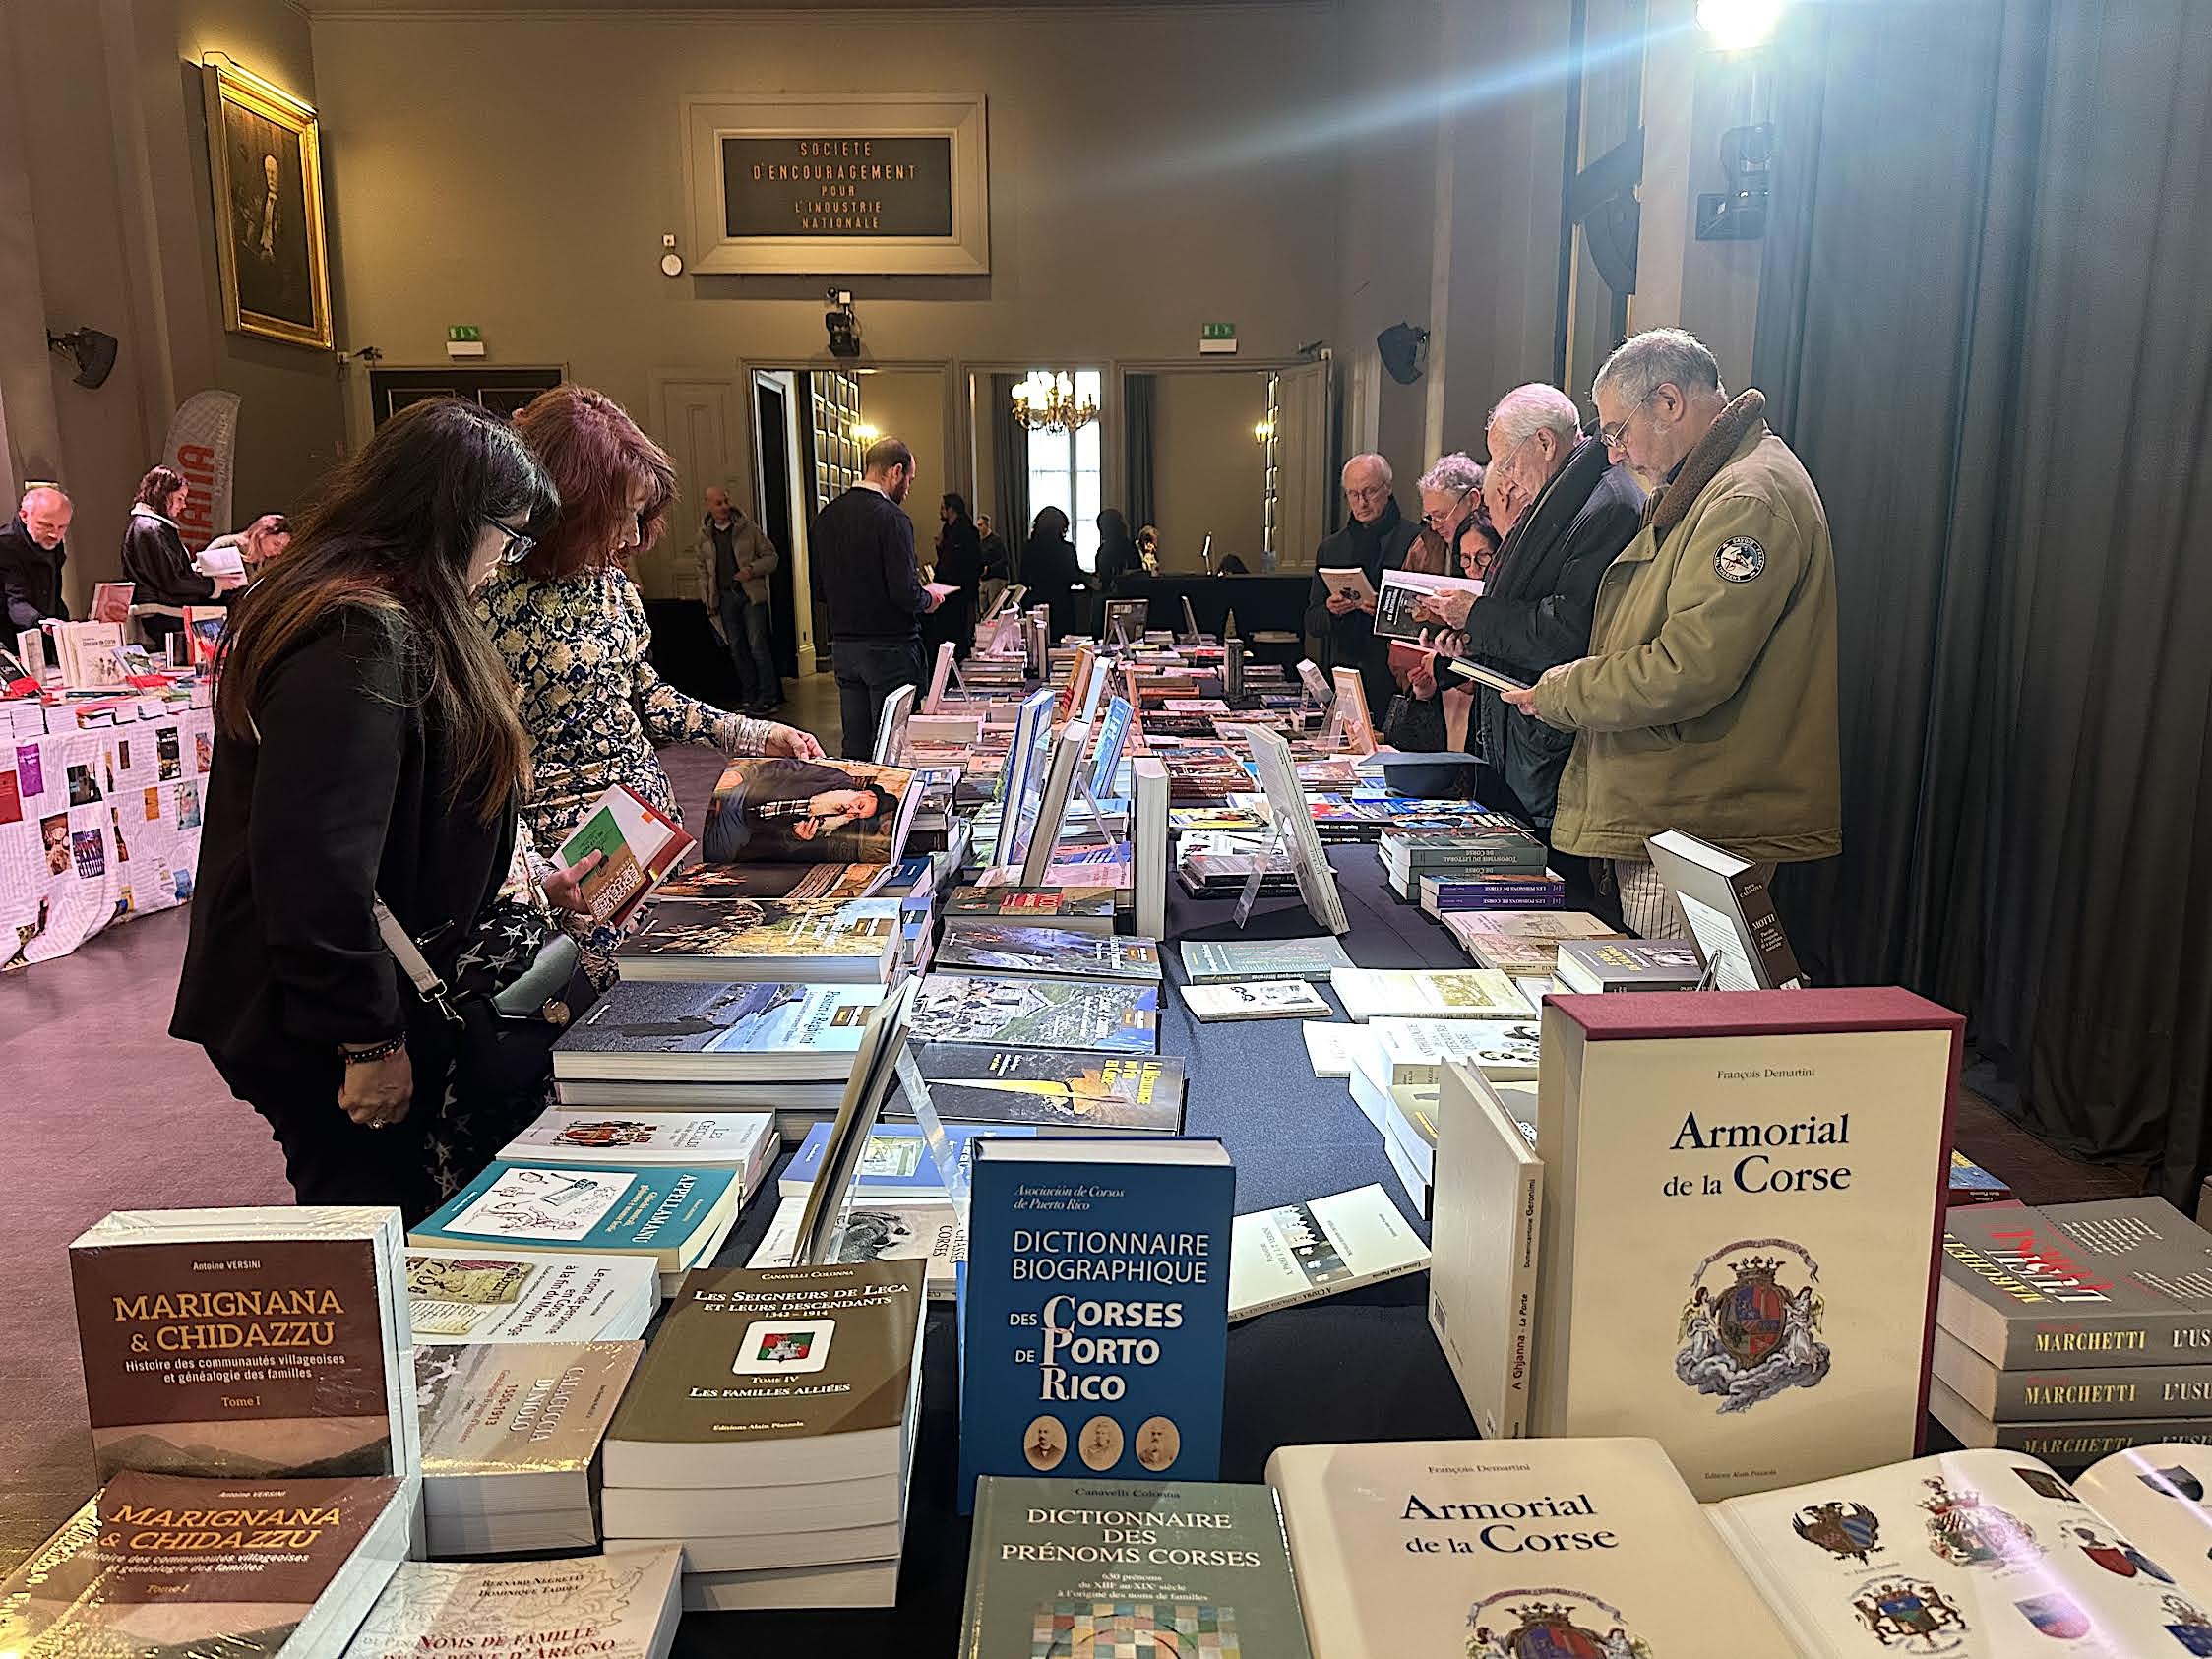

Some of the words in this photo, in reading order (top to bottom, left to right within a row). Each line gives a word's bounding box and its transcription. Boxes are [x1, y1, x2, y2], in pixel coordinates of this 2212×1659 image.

[800, 142, 873, 157] SOCIETE
[753, 162, 916, 181] D'ENCOURAGEMENT
[821, 185, 856, 197] POUR
[795, 200, 882, 214] L'INDUSTRIE
[802, 217, 879, 229] NATIONALE
[1752, 914, 1775, 930] MOTTI
[1716, 1068, 1762, 1081] François
[1765, 1068, 1815, 1079] Demartini
[1669, 1111, 1851, 1151] Armorial
[1663, 1175, 1694, 1198] de
[1700, 1175, 1723, 1196] la
[1733, 1153, 1853, 1197] Corse
[1015, 1184, 1073, 1198] Asociación
[1074, 1187, 1086, 1198] de
[1088, 1187, 1125, 1198] Corsos
[1526, 1179, 1536, 1216] Geronimi
[1014, 1198, 1027, 1210] de
[1030, 1199, 1065, 1211] Puerto
[1067, 1200, 1090, 1211] Rico
[932, 1225, 953, 1257] CORSES
[1014, 1230, 1209, 1257] DICTIONNAIRE
[193, 1260, 224, 1271] Antoine
[226, 1260, 261, 1270] VERSINI
[594, 1268, 612, 1277] Le
[1013, 1259, 1207, 1285] BIOGRAPHIQUE
[542, 1289, 559, 1301] du
[582, 1277, 601, 1296] nom
[693, 1290, 727, 1302] LES
[731, 1290, 829, 1302] SEIGNEURS
[833, 1288, 859, 1299] DE
[863, 1283, 909, 1296] LECA
[112, 1289, 344, 1321] MARIGNANA
[544, 1298, 571, 1318] Corse
[575, 1293, 590, 1306] de
[704, 1302, 725, 1312] ET
[728, 1303, 777, 1312] LEURS
[781, 1296, 892, 1311] DESCENDANTS
[1518, 1294, 1528, 1314] Porte
[546, 1304, 581, 1334] personne
[1010, 1313, 1037, 1326] DES
[1043, 1294, 1183, 1334] CORSES
[1519, 1315, 1526, 1327] La
[130, 1334, 150, 1353] &
[156, 1321, 335, 1352] CHIDAZZU
[2035, 1331, 2146, 1352] MARCHETTI
[1015, 1350, 1035, 1363] DE
[1039, 1328, 1160, 1366] PORTO
[1512, 1335, 1526, 1378] Ghjanna
[125, 1358, 172, 1373] Histoire
[174, 1357, 195, 1371] des
[198, 1354, 276, 1369] communautés
[278, 1352, 345, 1368] villageoises
[163, 1372, 175, 1383] et
[177, 1368, 242, 1384] généalogie
[244, 1368, 265, 1381] des
[267, 1366, 312, 1380] familles
[1039, 1366, 1126, 1401] RICO
[689, 1387, 718, 1397] LES
[722, 1388, 790, 1397] FAMILLES
[1512, 1382, 1522, 1390] A
[2025, 1384, 2136, 1405] MARCHETTI
[221, 1395, 253, 1408] Tome
[528, 1367, 584, 1444] CALACUCCIA
[2023, 1437, 2134, 1454] MARCHETTI
[1427, 1462, 1473, 1475] François
[1476, 1462, 1531, 1474] Demartini
[1133, 1487, 1180, 1499] Colonna
[108, 1505, 341, 1527] MARIGNANA
[1400, 1493, 1599, 1522] Armorial
[1027, 1508, 1232, 1530] DICTIONNAIRE
[100, 1532, 122, 1547] &
[129, 1529, 322, 1551] CHIDAZZU
[1102, 1528, 1157, 1545] DES
[1405, 1535, 1443, 1555] de
[1448, 1536, 1475, 1554] la
[1479, 1524, 1621, 1555] Corse
[129, 1554, 150, 1564] des
[236, 1552, 310, 1565] villageoises
[1001, 1541, 1140, 1564] PRÉNOMS
[1148, 1547, 1260, 1567] CORSES
[190, 1564, 212, 1572] des
[214, 1563, 265, 1573] familles
[1122, 1573, 1162, 1583] prénoms
[1108, 1590, 1126, 1599] des
[1155, 1592, 1168, 1601] de
[1170, 1592, 1209, 1602] familles
[419, 1635, 474, 1650] NOMS
[481, 1635, 505, 1647] DE
[514, 1626, 598, 1646] FAMILLE
